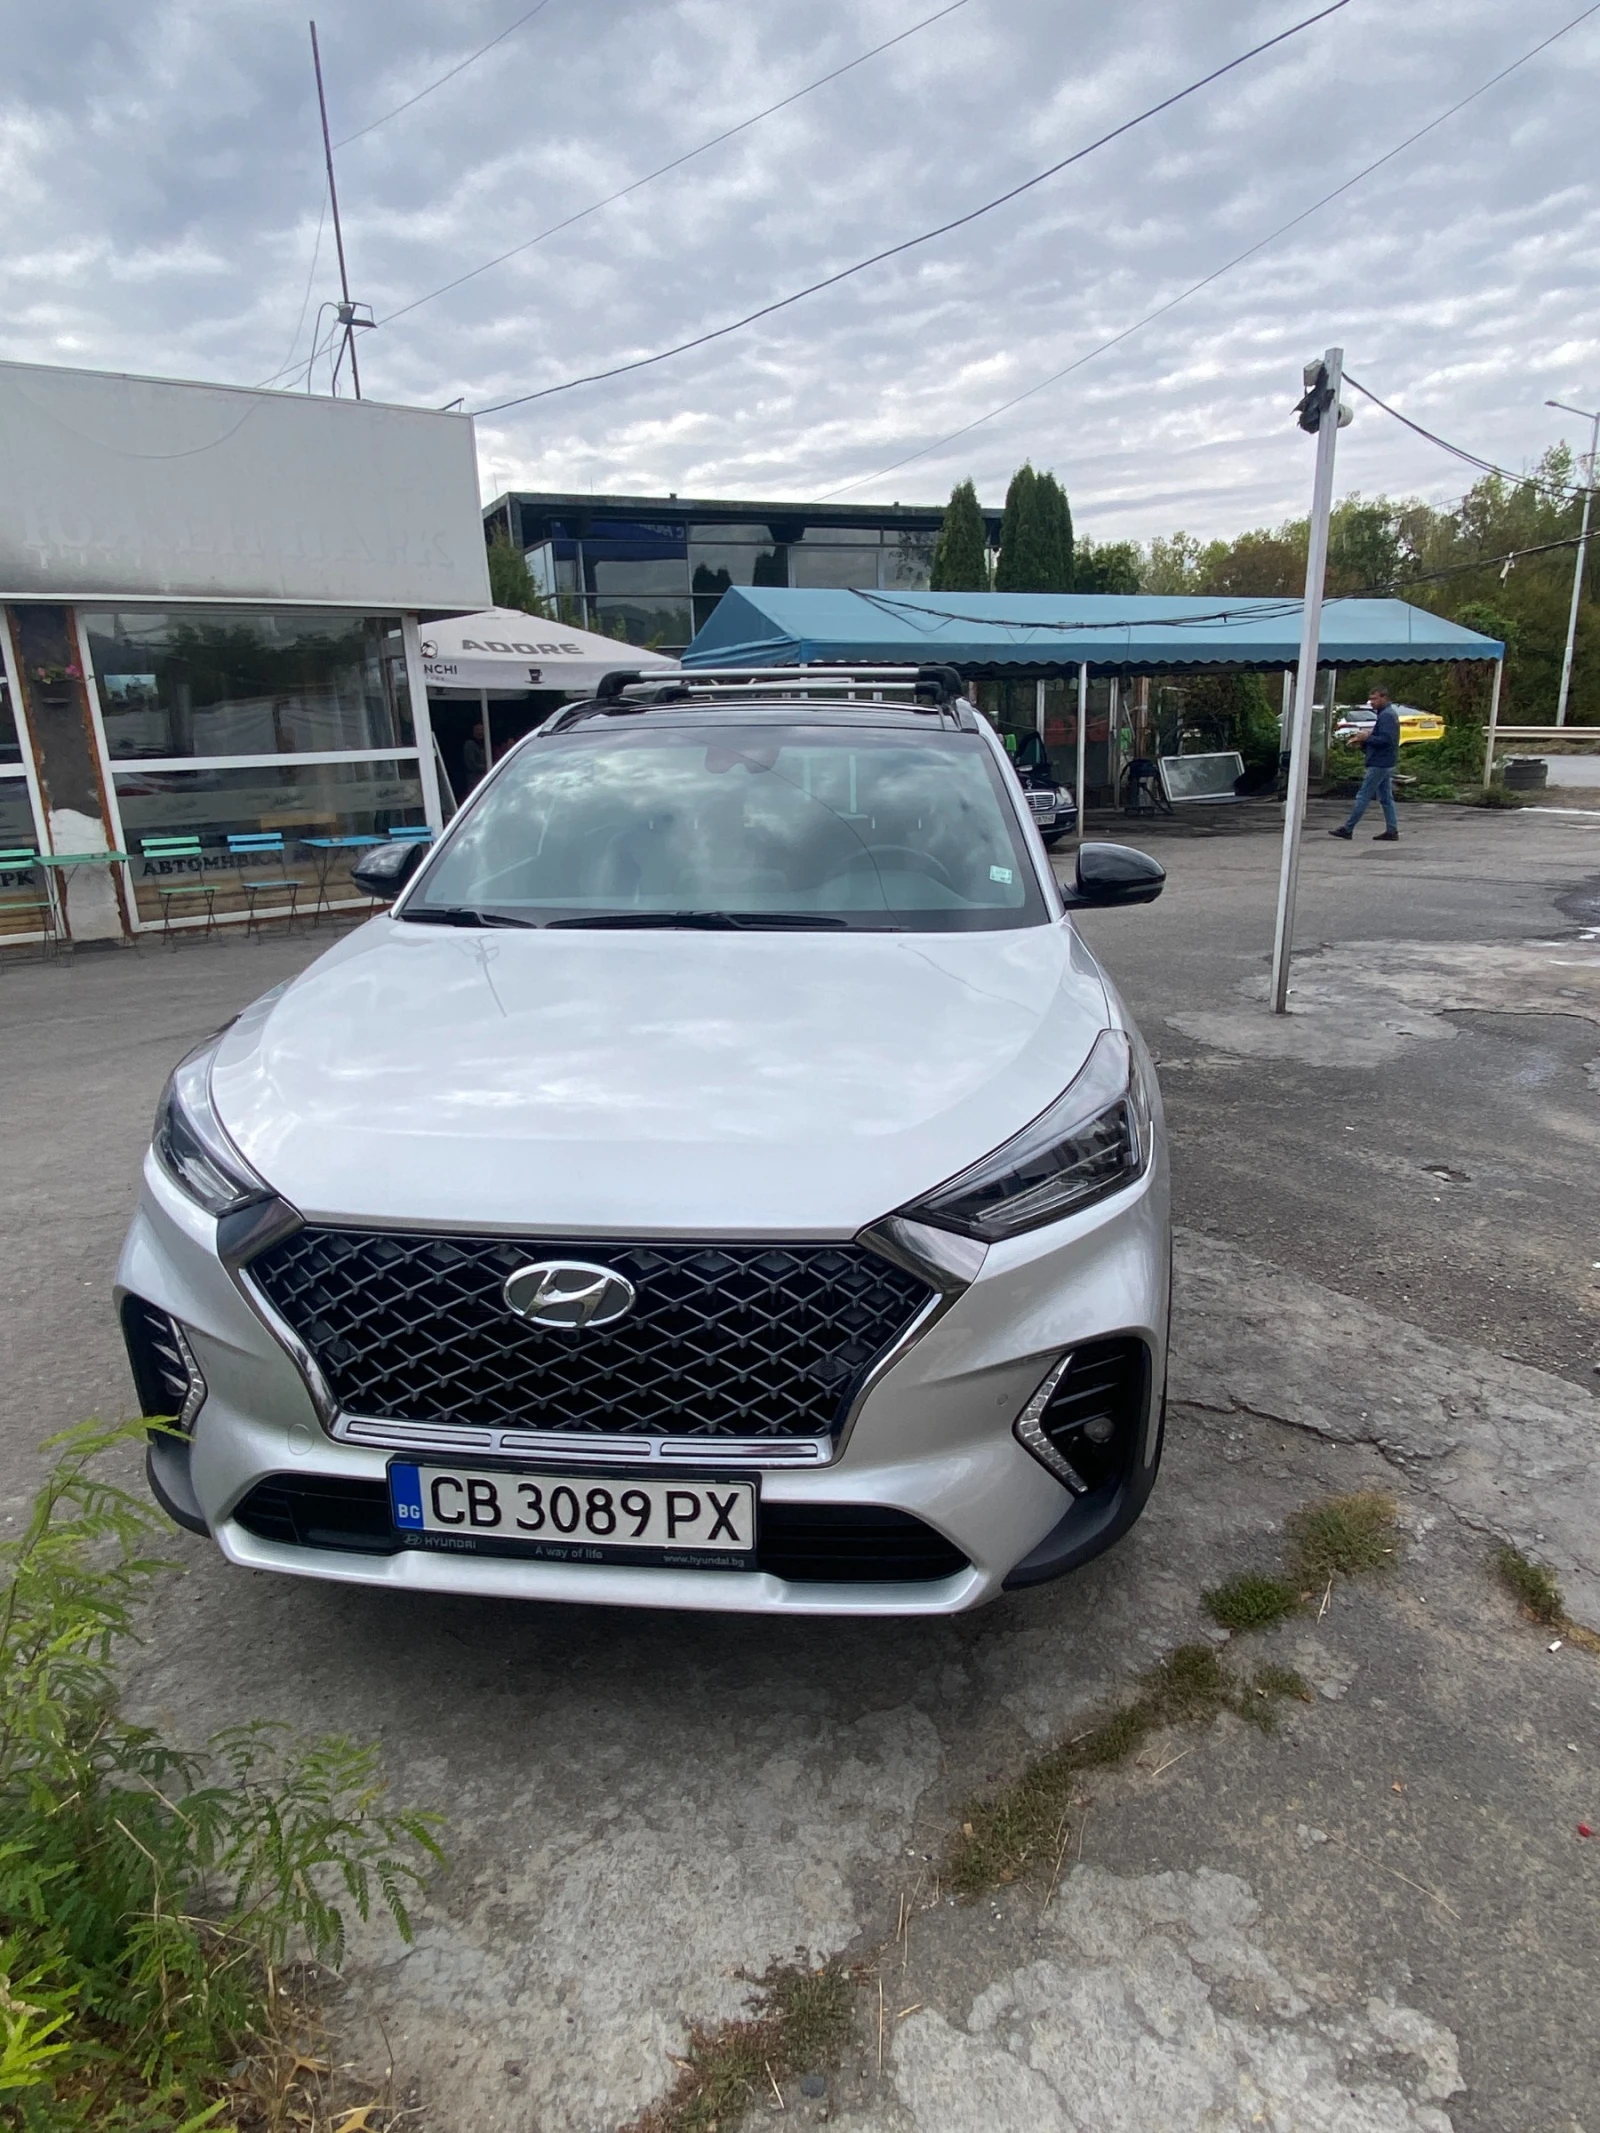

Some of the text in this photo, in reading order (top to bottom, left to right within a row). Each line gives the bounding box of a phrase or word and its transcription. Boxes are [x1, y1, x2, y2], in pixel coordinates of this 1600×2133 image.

[462, 639, 584, 655] ADORE
[0, 869, 36, 887] РК
[398, 1505, 421, 1520] BG
[430, 1476, 741, 1542] CB 3089 PX
[425, 1537, 476, 1549] HYUNDAI
[535, 1546, 603, 1559] A way of life
[664, 1554, 745, 1567] www.hyundai.bg
